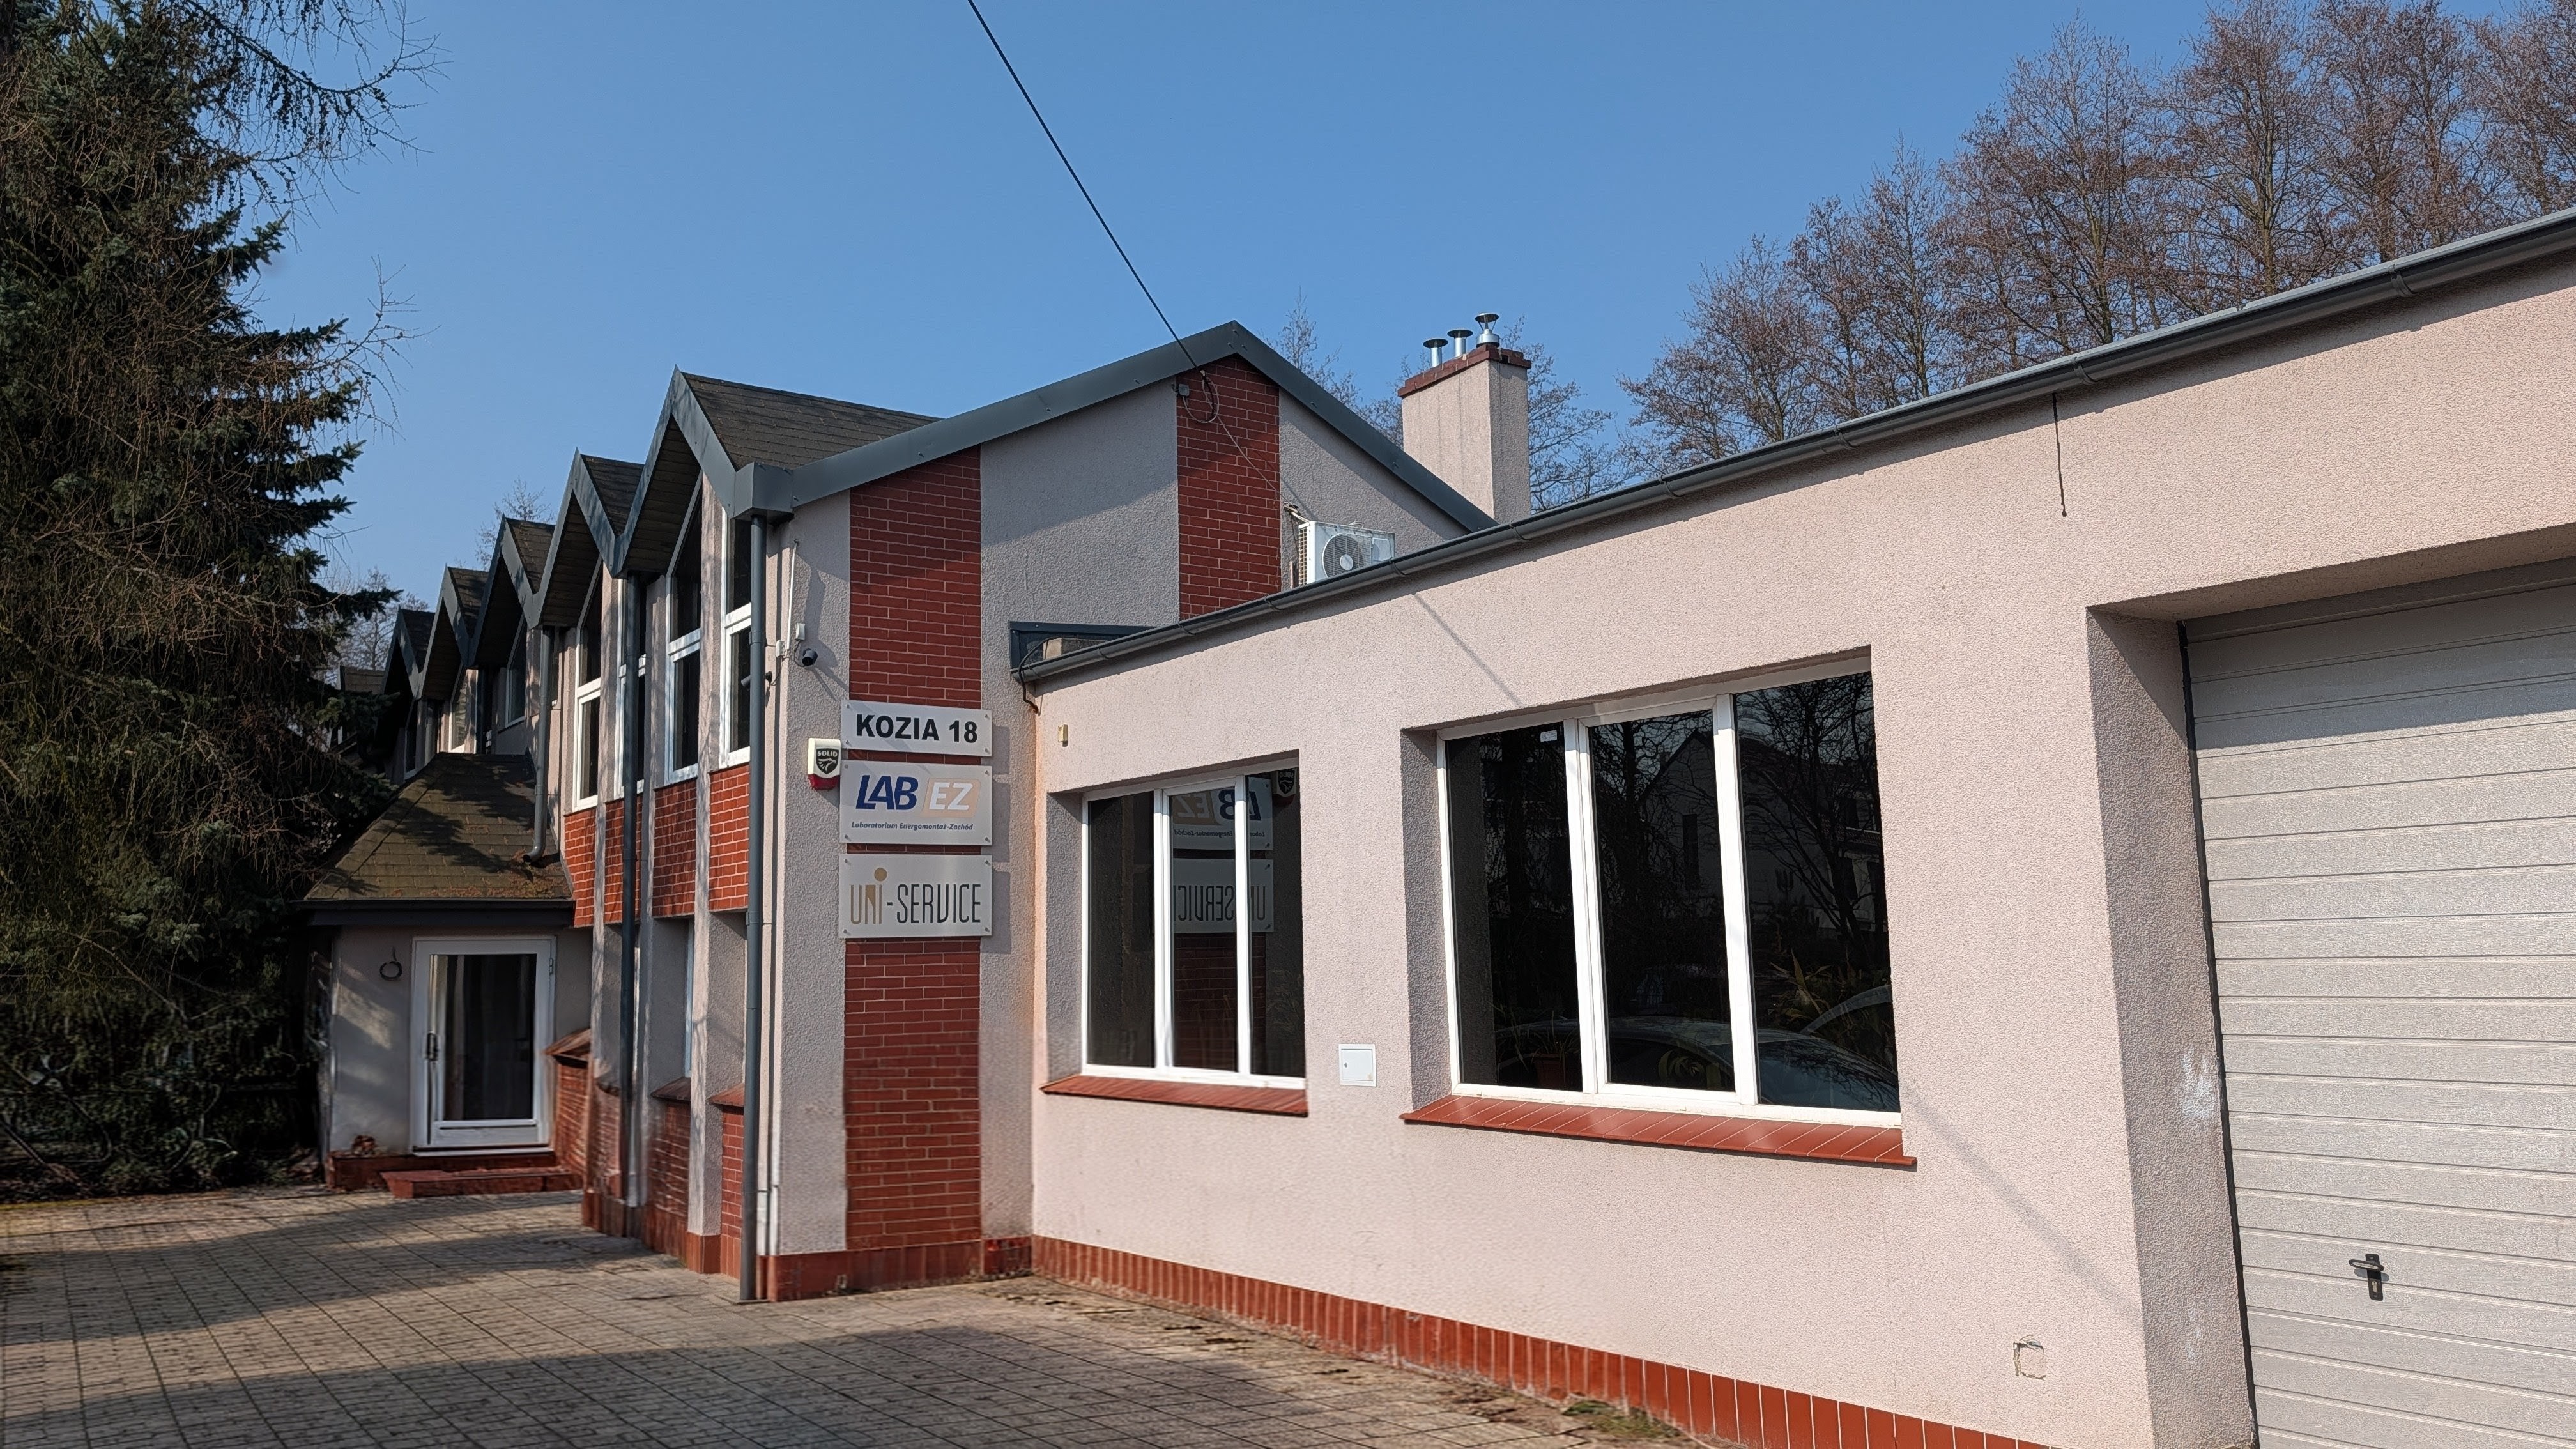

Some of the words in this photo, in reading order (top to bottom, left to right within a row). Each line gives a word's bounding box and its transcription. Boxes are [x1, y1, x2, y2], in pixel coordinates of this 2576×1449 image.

[855, 713, 940, 742] KOZIA
[949, 720, 978, 744] 18
[855, 774, 919, 810] LAB
[929, 781, 973, 810] EZ
